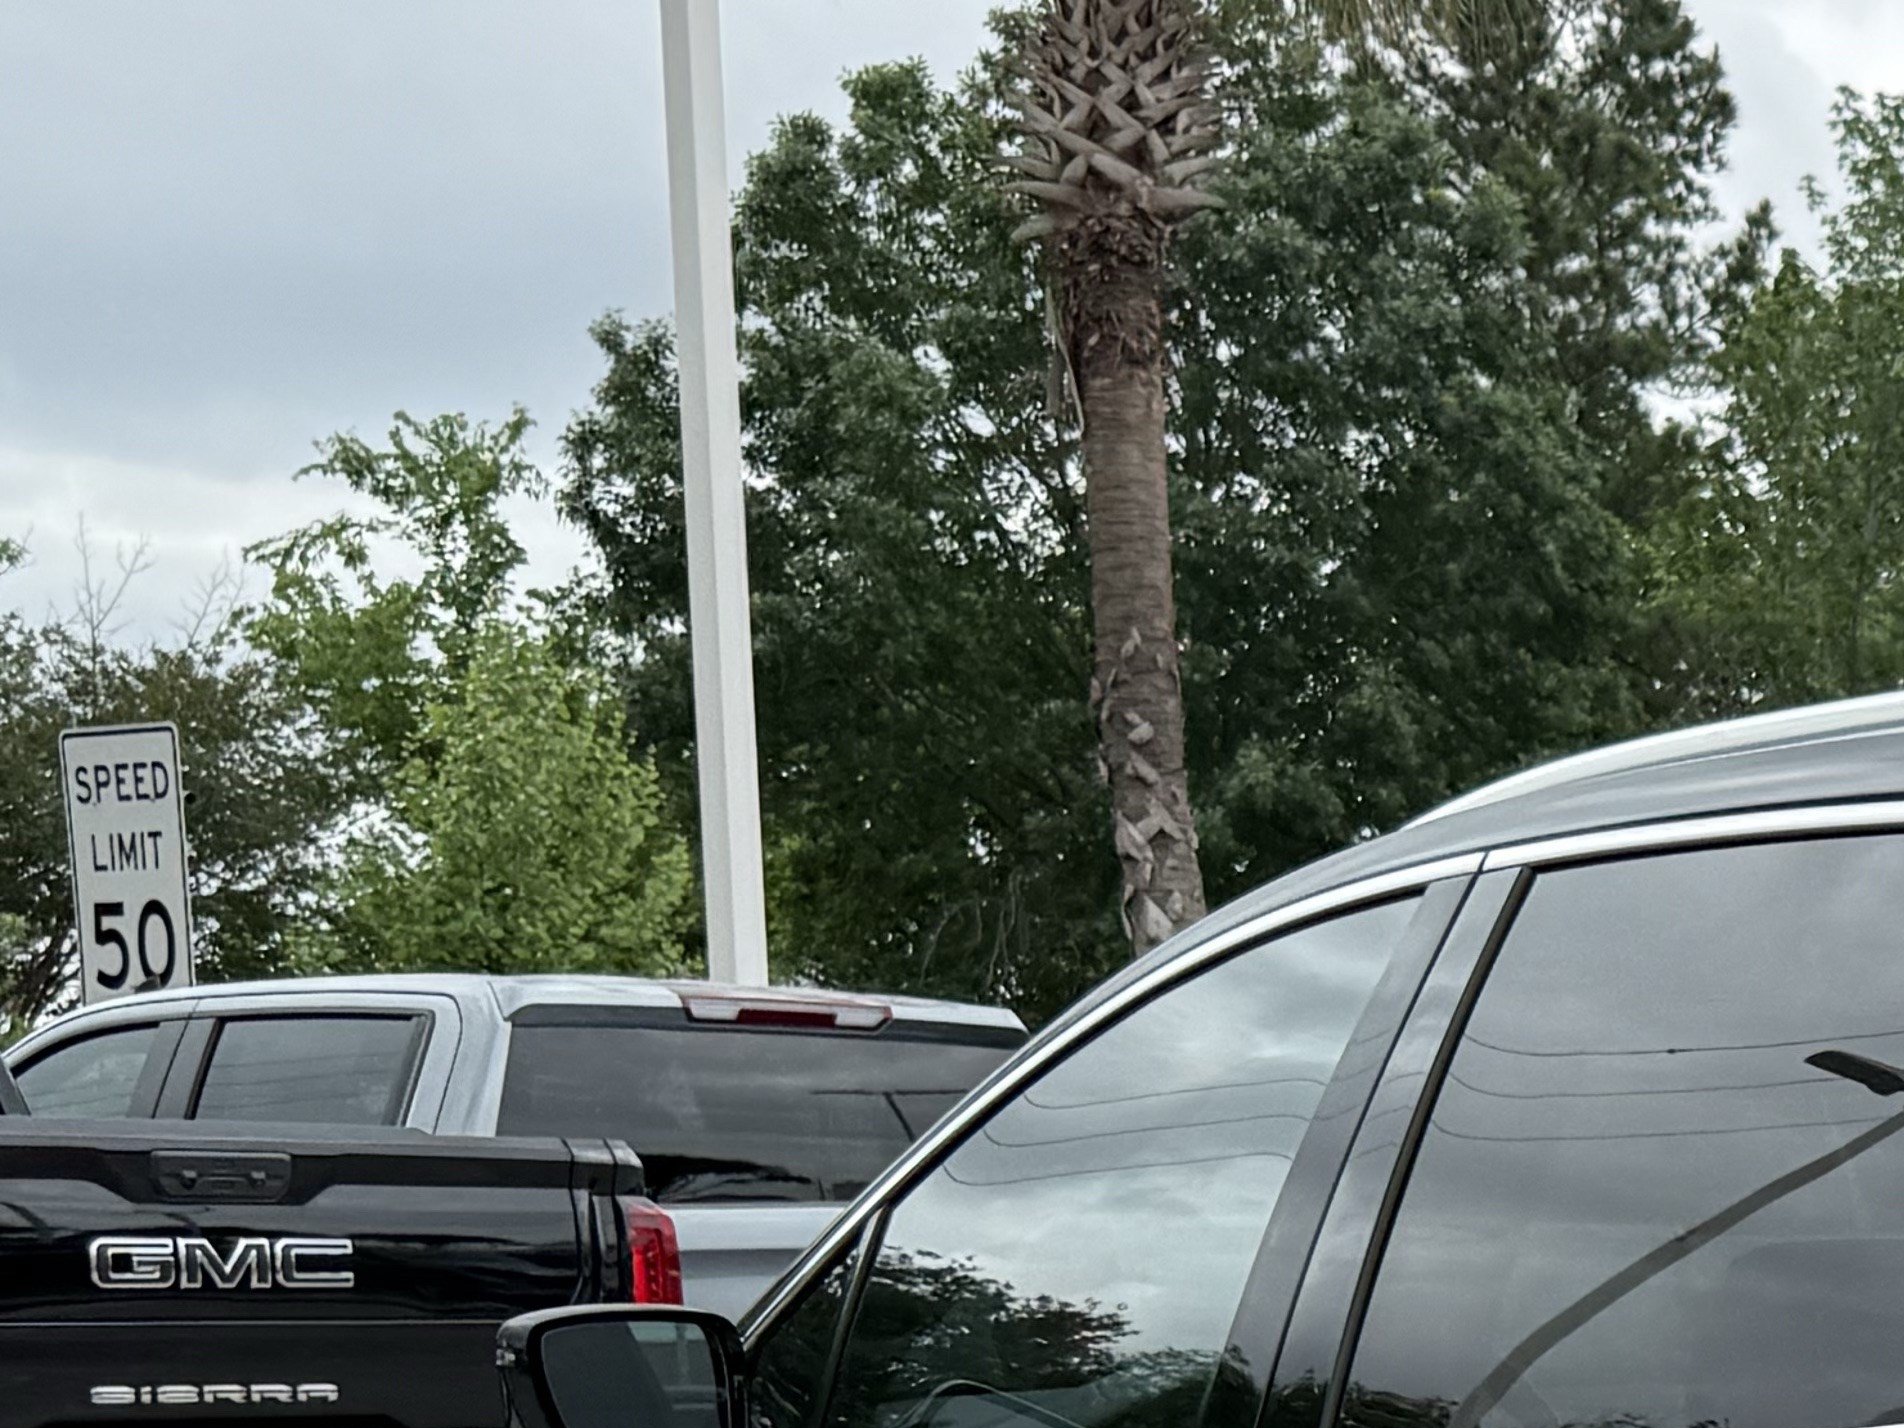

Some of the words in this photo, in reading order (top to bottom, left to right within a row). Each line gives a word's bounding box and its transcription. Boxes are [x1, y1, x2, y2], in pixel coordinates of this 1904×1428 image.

[75, 761, 169, 803] SPEED
[91, 831, 162, 872] LIMIT
[94, 899, 176, 991] 50
[89, 1236, 354, 1289] GMC
[90, 1383, 339, 1404] SIERRA
